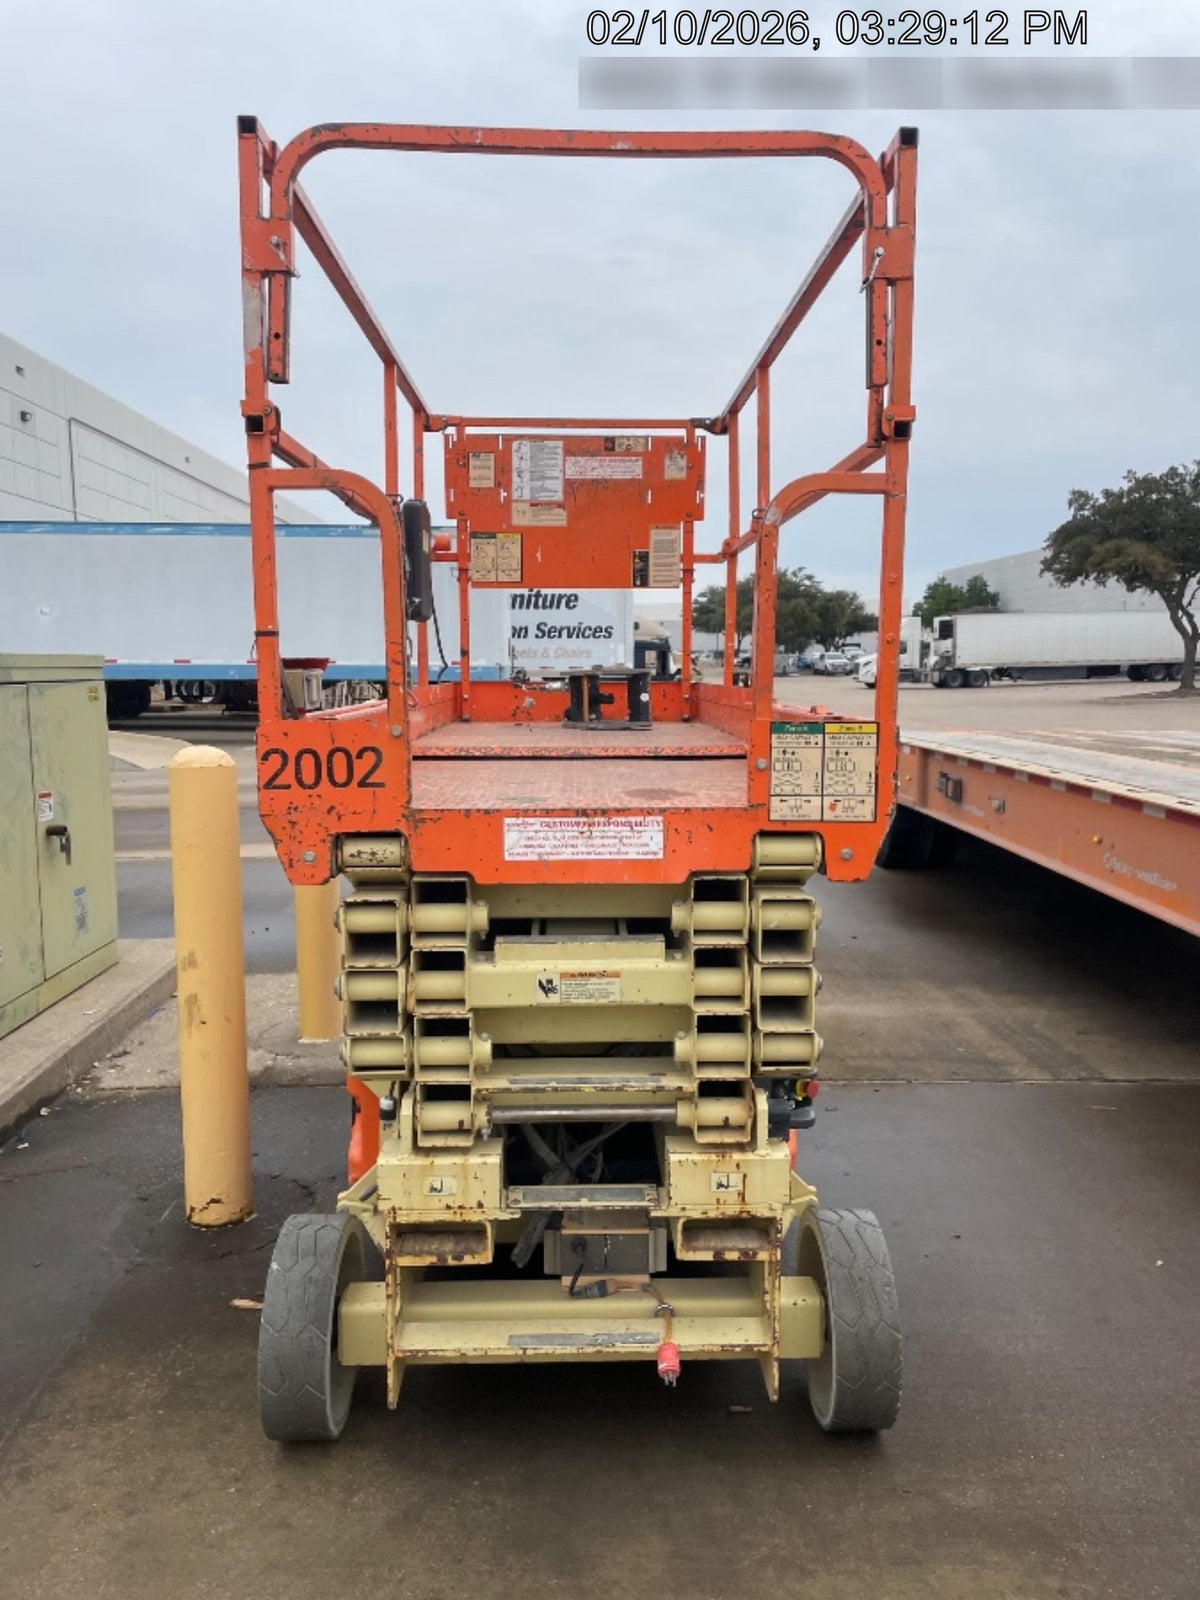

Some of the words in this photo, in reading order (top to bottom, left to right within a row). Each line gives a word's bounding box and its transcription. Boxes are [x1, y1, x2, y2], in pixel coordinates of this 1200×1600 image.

[510, 588, 579, 610] niture
[534, 621, 614, 639] Services
[260, 746, 386, 790] 2002
